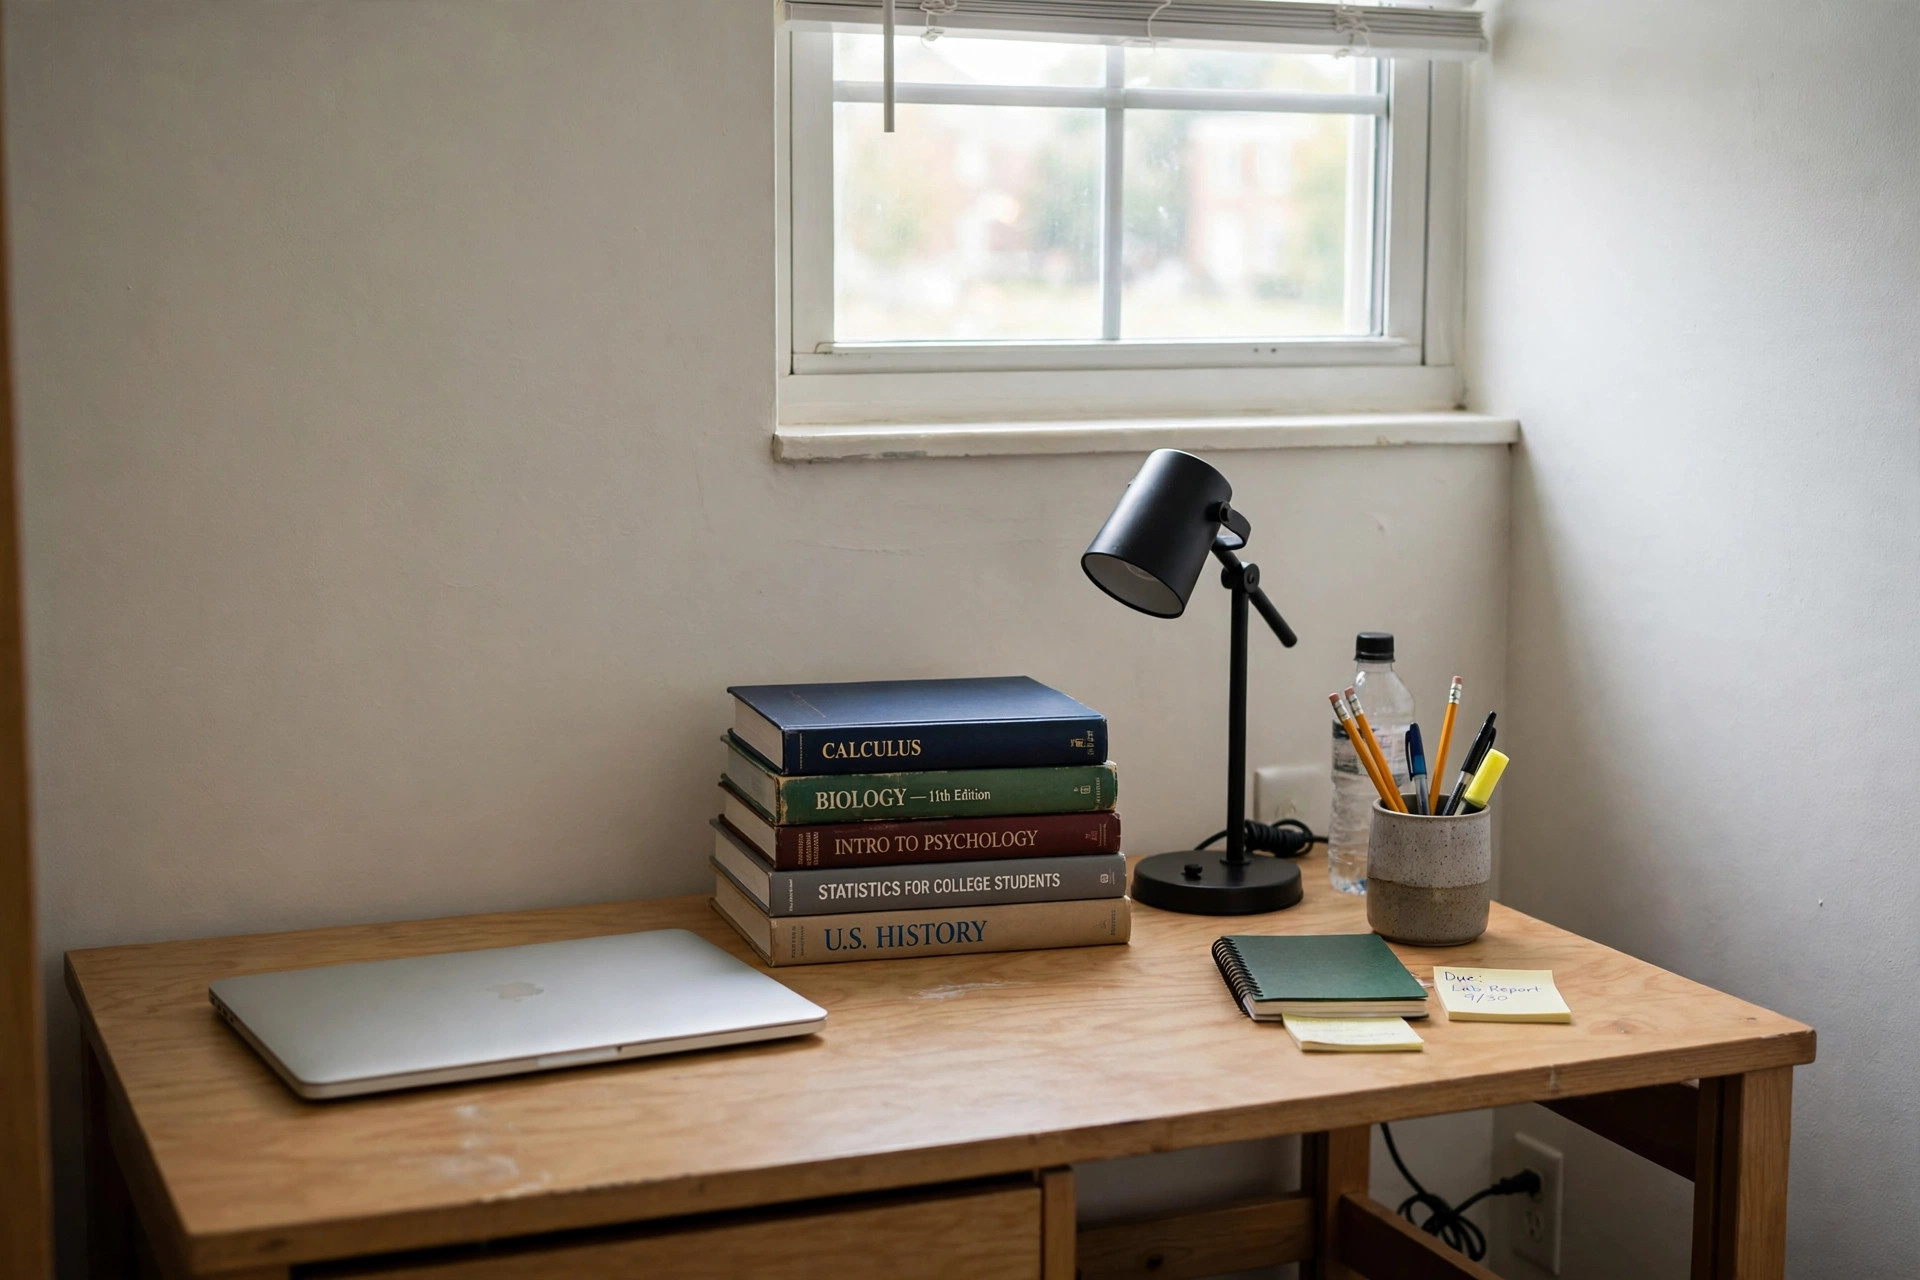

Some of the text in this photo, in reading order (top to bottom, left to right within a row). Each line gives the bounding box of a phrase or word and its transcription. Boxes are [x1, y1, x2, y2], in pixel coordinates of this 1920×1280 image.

[822, 739, 922, 759] CALCULUS
[815, 788, 907, 810] BIOLOGY
[929, 789, 951, 803] 11th
[954, 788, 991, 801] Edition
[835, 836, 890, 855] INTRO
[894, 835, 919, 852] TO
[924, 830, 1039, 850] PSYCHOLOGY
[818, 873, 1061, 900] STATISTICS FOR COLLEGE STUDENTS
[824, 927, 867, 951] U.S.
[875, 920, 988, 948] HISTORY
[1444, 971, 1483, 983] Due:
[1452, 984, 1541, 994] Lab Report
[1464, 993, 1508, 1003] 9/30
